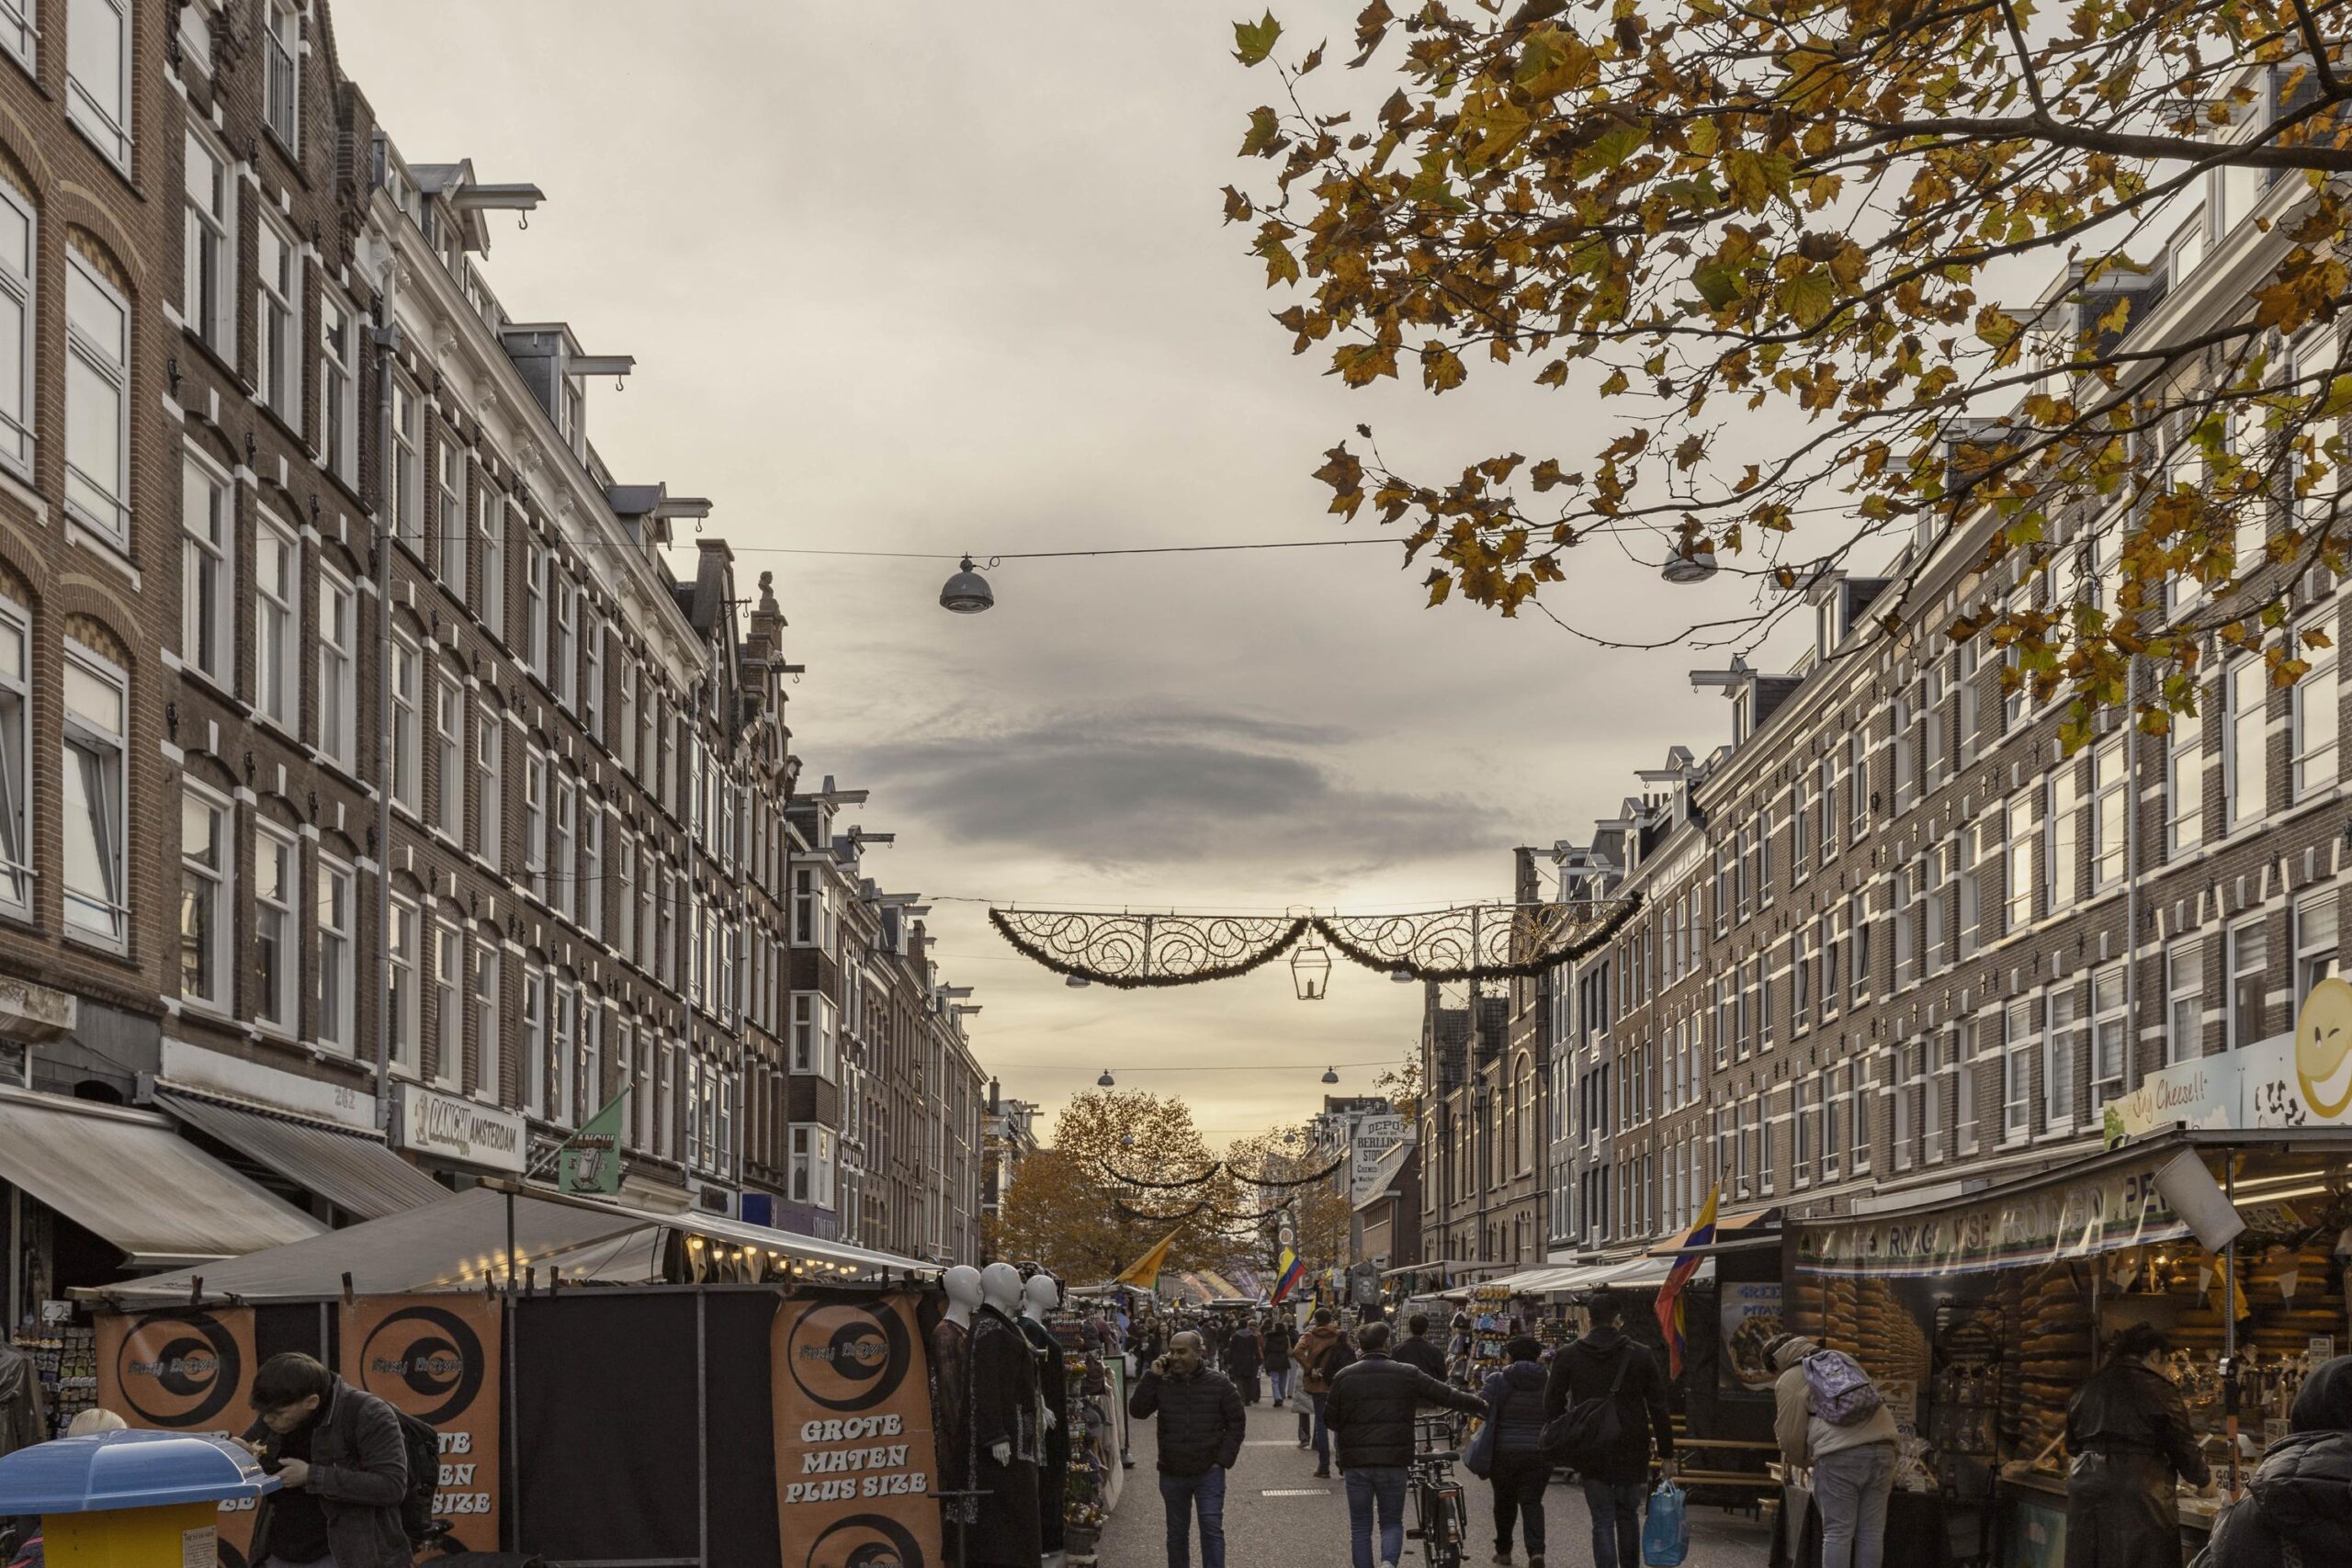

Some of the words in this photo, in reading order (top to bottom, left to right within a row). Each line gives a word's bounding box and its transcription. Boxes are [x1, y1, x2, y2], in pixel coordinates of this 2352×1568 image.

[2132, 1089, 2153, 1123] Say
[2159, 1071, 2205, 1110] Cheese!!
[429, 1099, 470, 1144] RANCHI
[469, 1116, 516, 1153] AMSTERDAM
[801, 1414, 902, 1443] GROTE
[801, 1444, 910, 1474] MATEN
[432, 1493, 491, 1514] SIZE
[785, 1477, 857, 1504] PLUS
[862, 1472, 927, 1497] SIZE
